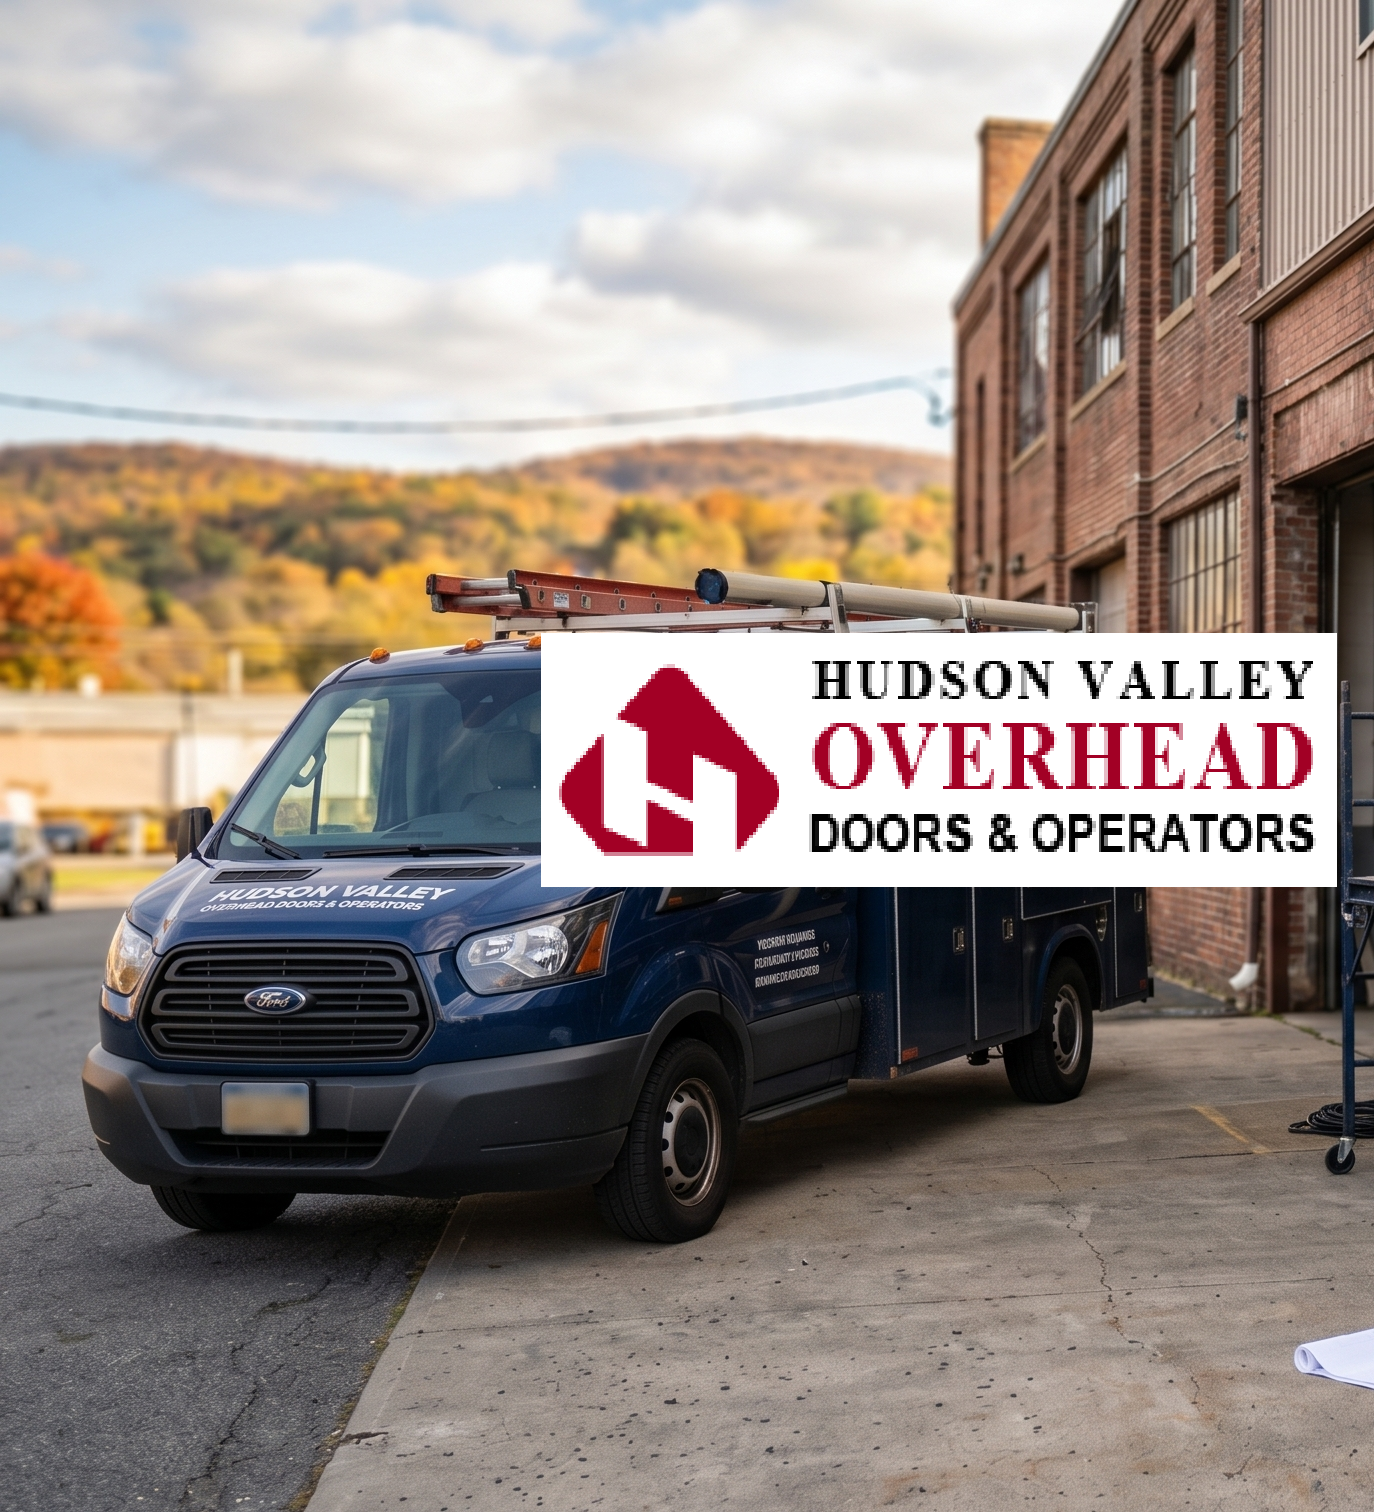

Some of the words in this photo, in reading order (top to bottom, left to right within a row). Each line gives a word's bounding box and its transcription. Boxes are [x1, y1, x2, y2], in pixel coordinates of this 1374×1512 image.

[208, 885, 339, 903] HUDSON
[342, 884, 457, 900] VALLEY
[274, 900, 326, 909] DOORS
[324, 900, 337, 908] &
[338, 900, 425, 911] OPERATORS
[256, 991, 291, 1008] Ford
